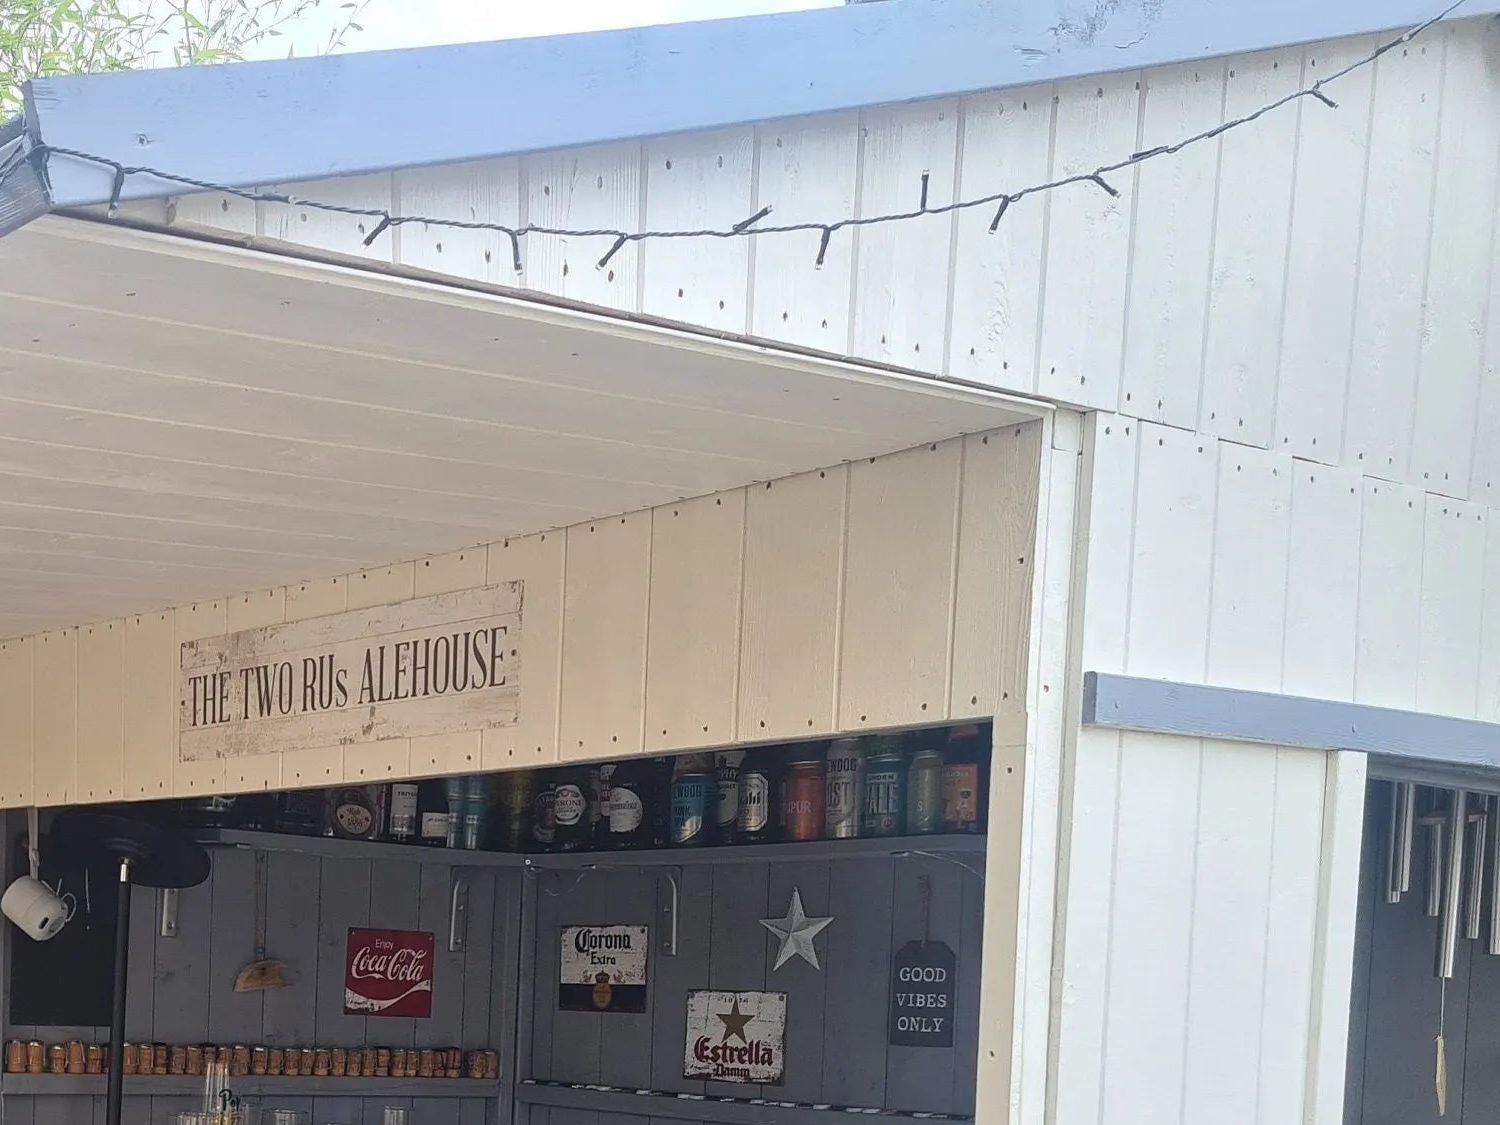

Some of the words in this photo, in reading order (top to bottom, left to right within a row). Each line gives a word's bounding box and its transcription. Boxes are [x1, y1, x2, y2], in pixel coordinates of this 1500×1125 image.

[188, 671, 231, 727] THE
[240, 661, 294, 720] TWO
[301, 653, 349, 713] RUs
[357, 625, 509, 705] ALEHOUSE
[375, 939, 394, 950] Enjoy
[575, 928, 631, 956] Corona
[351, 946, 428, 981] Coca-Cola
[590, 951, 616, 965] Extra
[899, 967, 946, 982] GOOD
[896, 993, 947, 1008] VIBES
[897, 1016, 944, 1032] ONLY
[694, 1035, 773, 1066] Estrella
[713, 1063, 750, 1079] Damm
